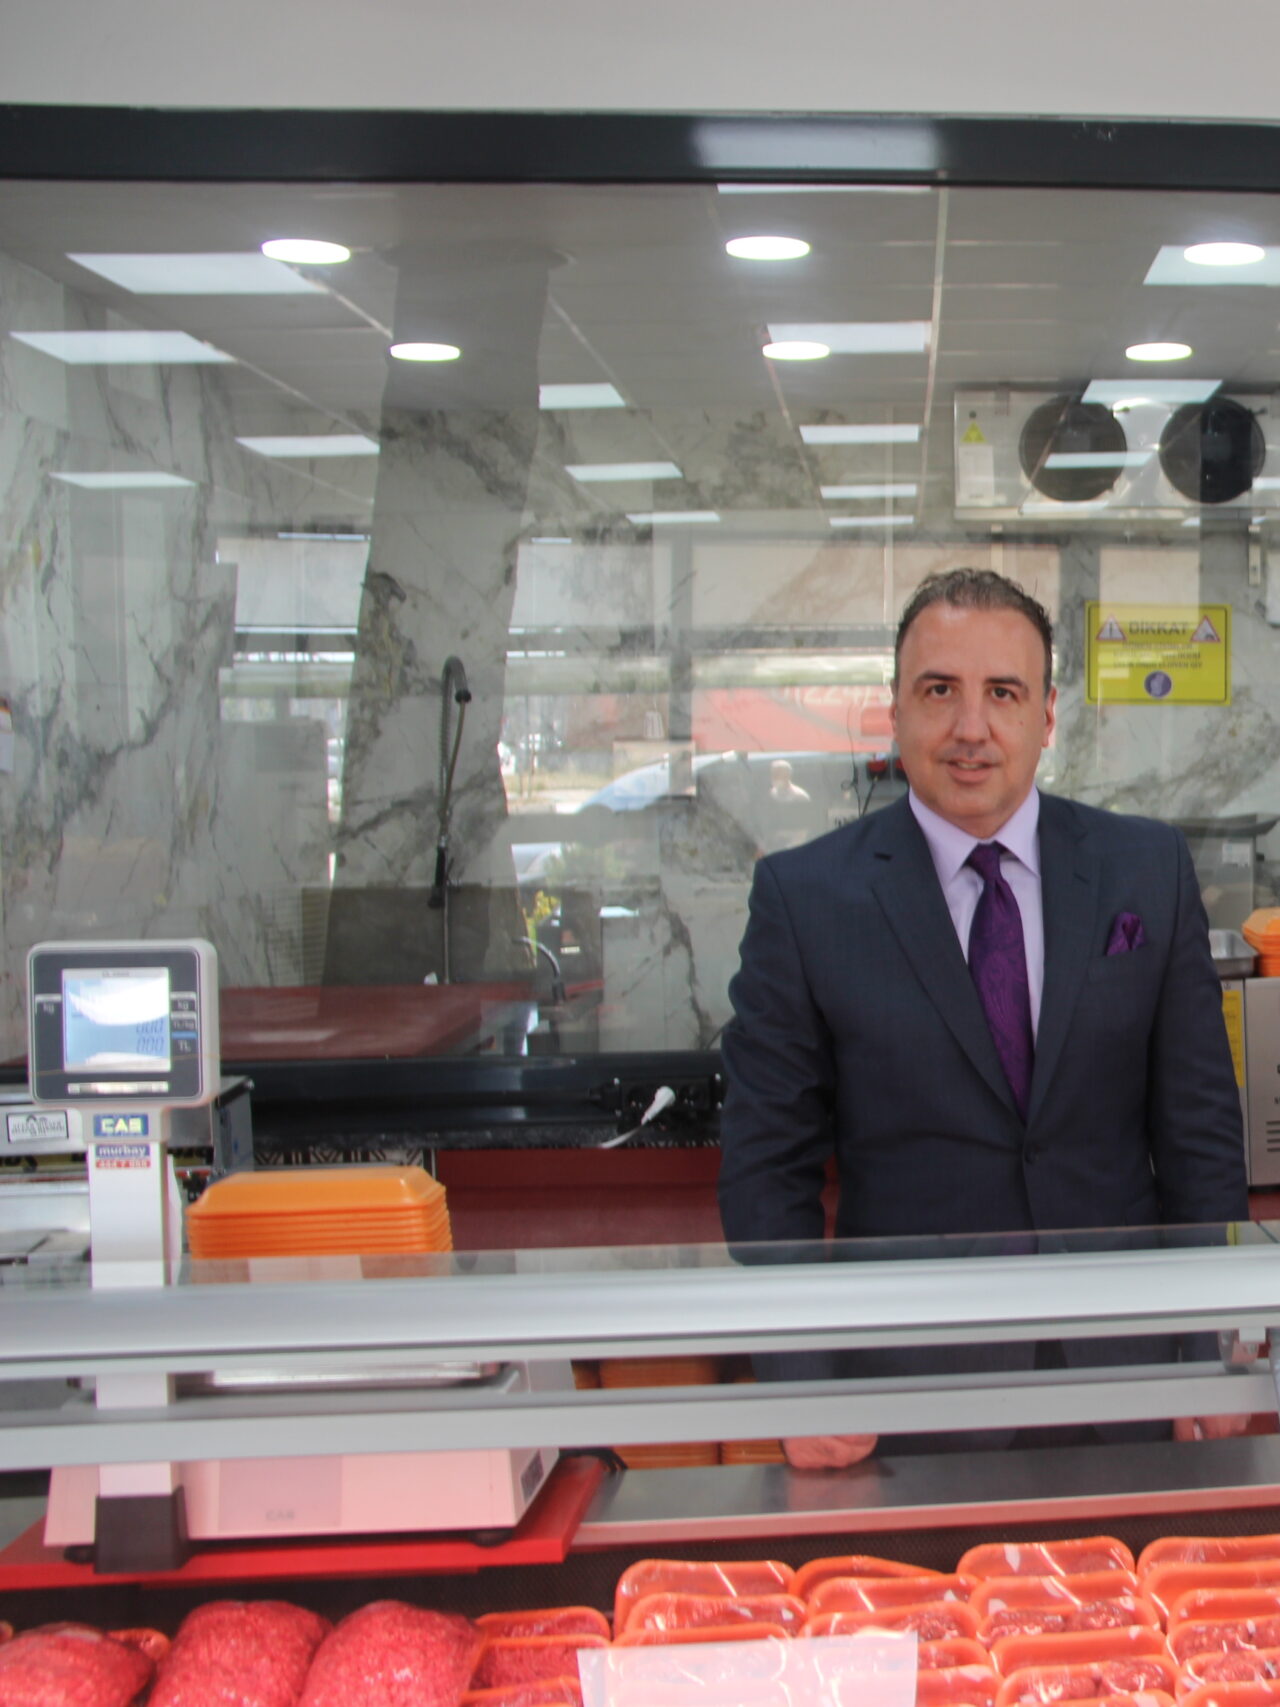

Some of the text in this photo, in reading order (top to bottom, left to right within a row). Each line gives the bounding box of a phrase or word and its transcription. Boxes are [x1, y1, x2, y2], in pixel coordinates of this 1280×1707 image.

[1129, 619, 1188, 635] DİKKAT
[177, 1039, 191, 1052] TL
[101, 1117, 142, 1134] CAS
